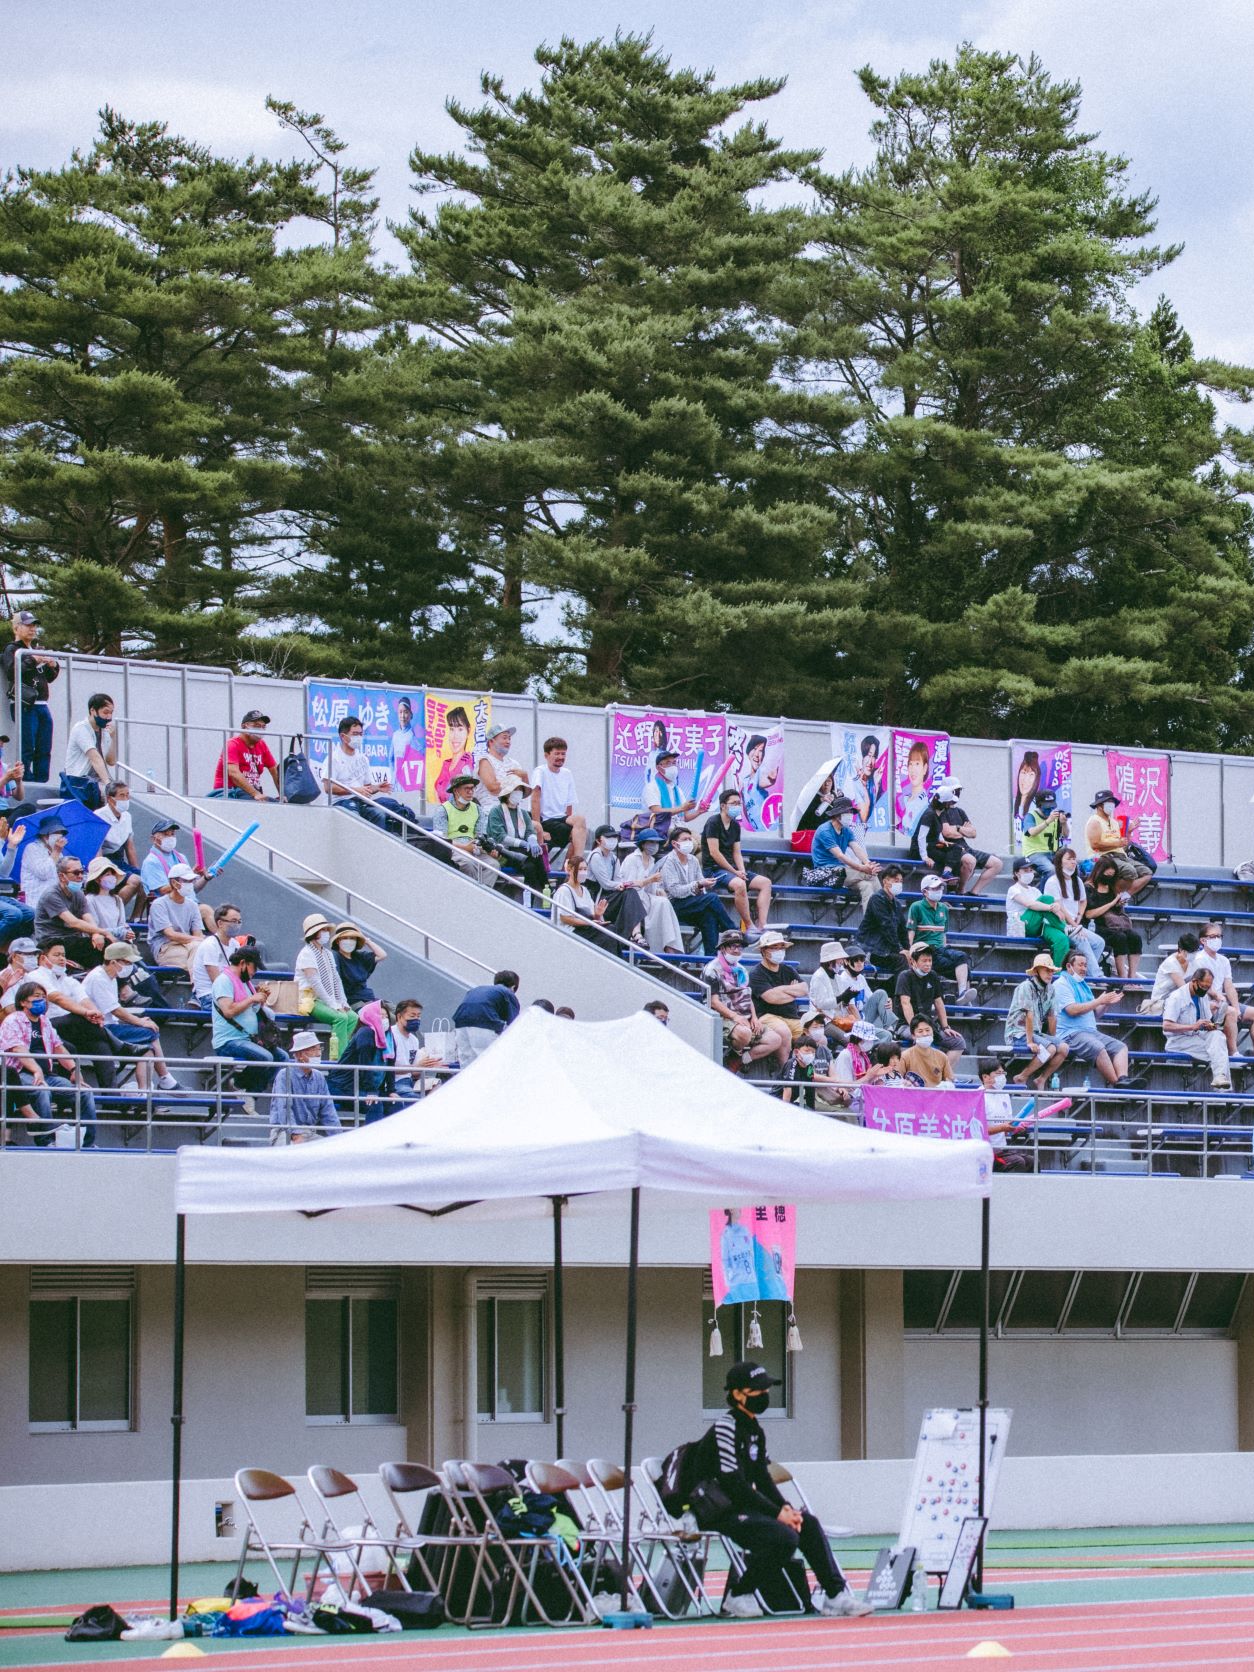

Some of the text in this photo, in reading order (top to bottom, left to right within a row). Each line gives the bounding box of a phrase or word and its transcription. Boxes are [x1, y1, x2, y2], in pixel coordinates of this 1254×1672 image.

[311, 695, 390, 731] 松原 ゆき
[614, 719, 654, 755] 辻野
[402, 760, 424, 786] 17
[873, 807, 886, 827] 13
